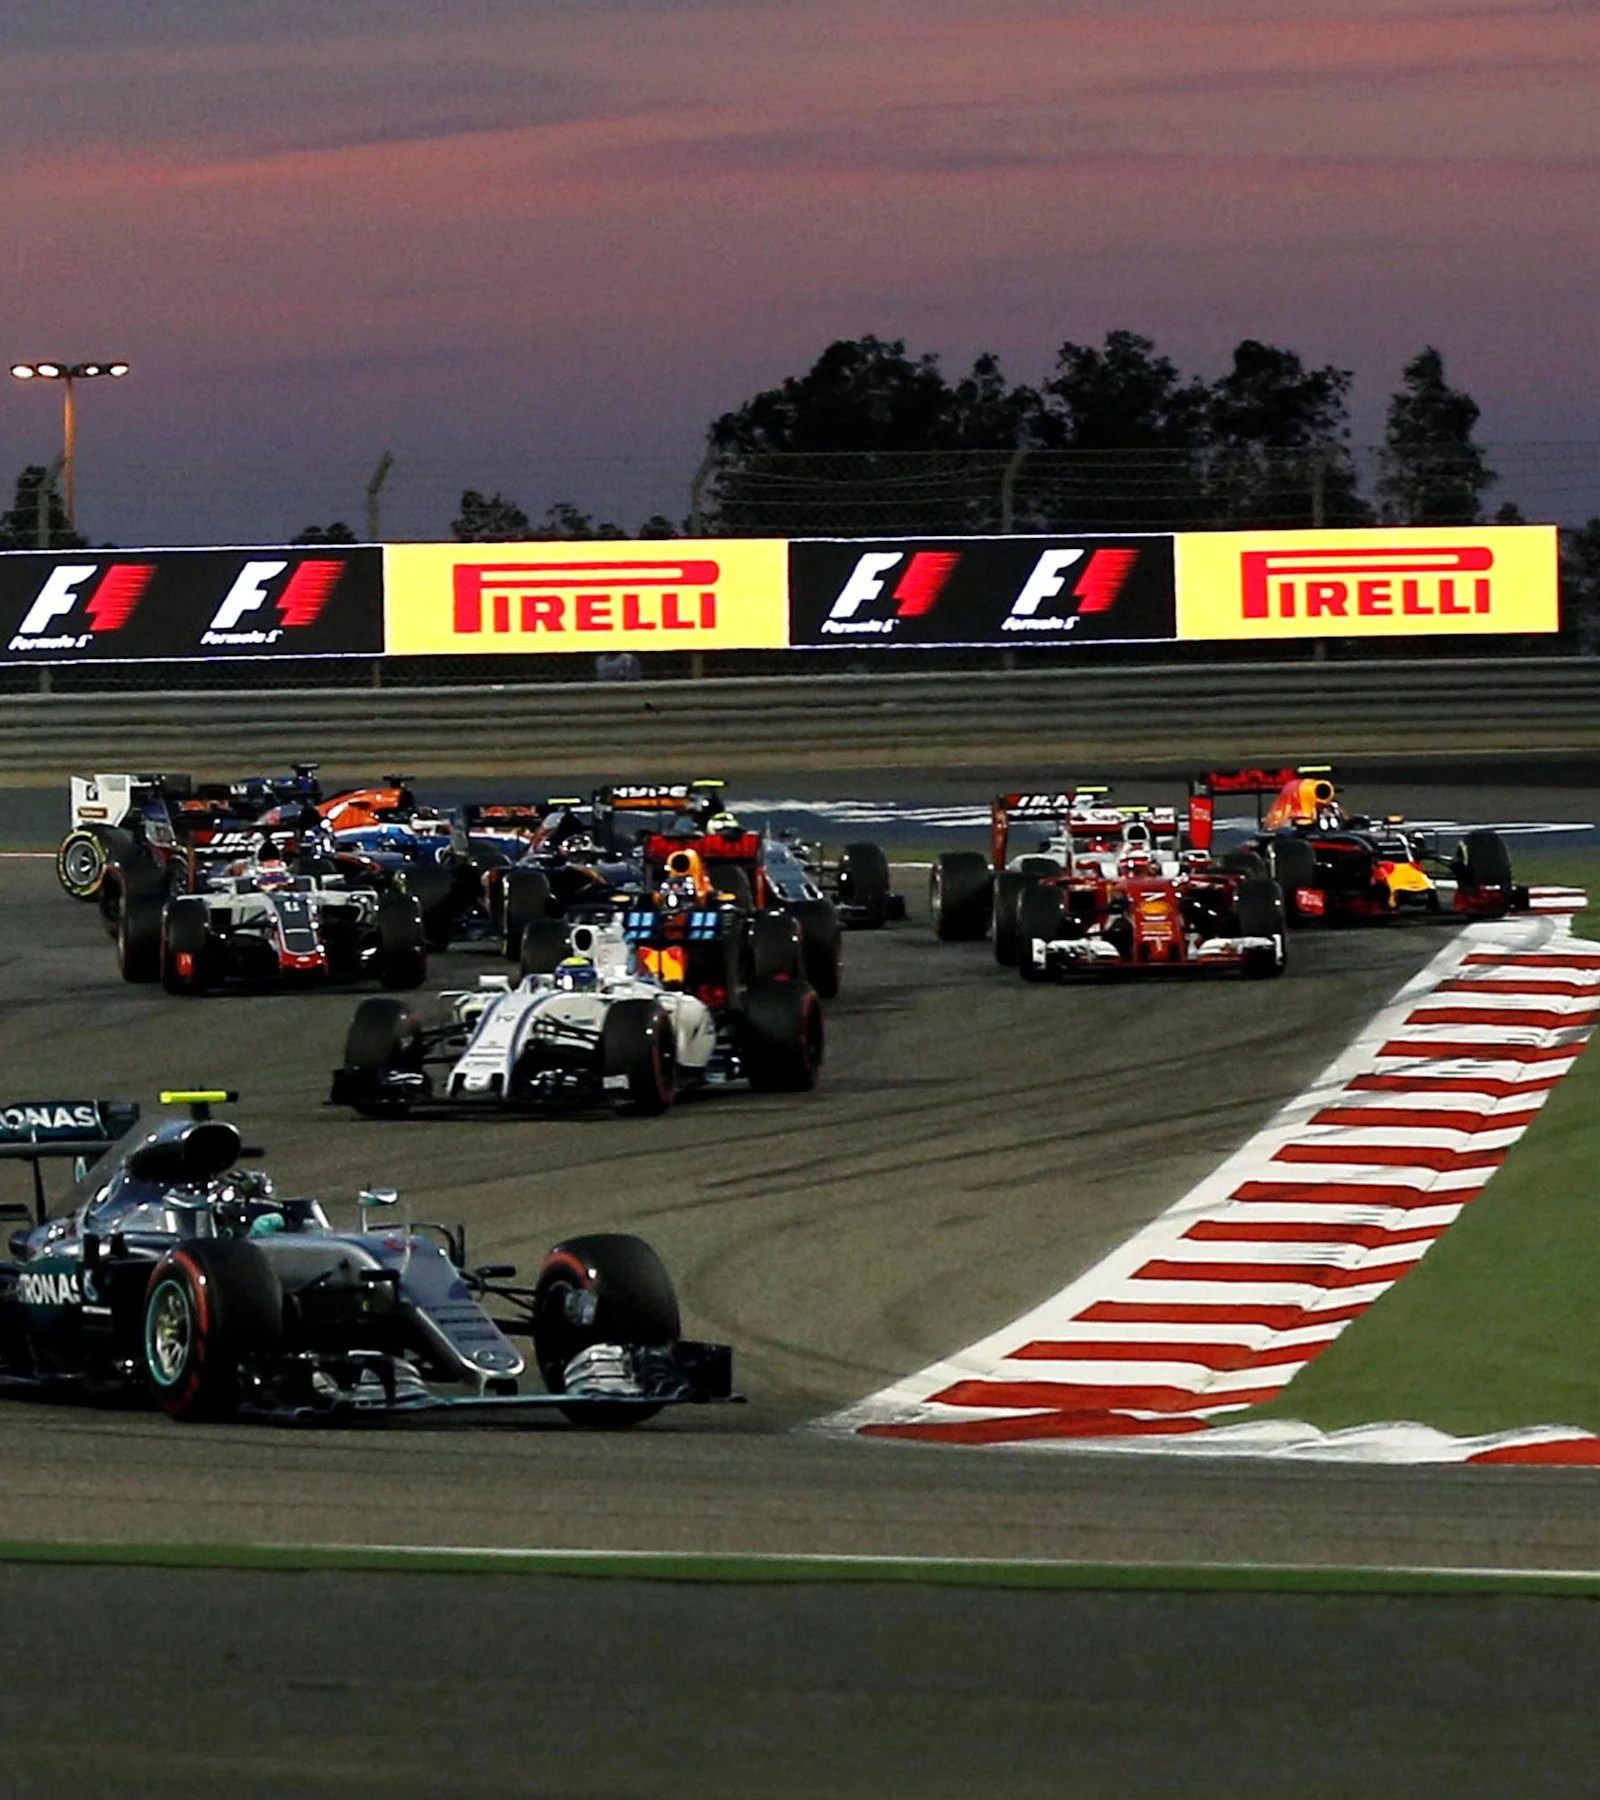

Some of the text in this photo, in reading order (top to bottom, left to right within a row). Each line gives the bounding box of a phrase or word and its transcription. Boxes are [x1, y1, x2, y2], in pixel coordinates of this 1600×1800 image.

[19, 564, 159, 633] F1
[210, 560, 348, 629] F1
[453, 560, 720, 633] PIRELLI
[828, 551, 961, 617] F1
[1010, 549, 1141, 615] F1
[1240, 546, 1494, 619] PIRELLI
[8, 635, 76, 650] Formula
[201, 630, 264, 645] Formula
